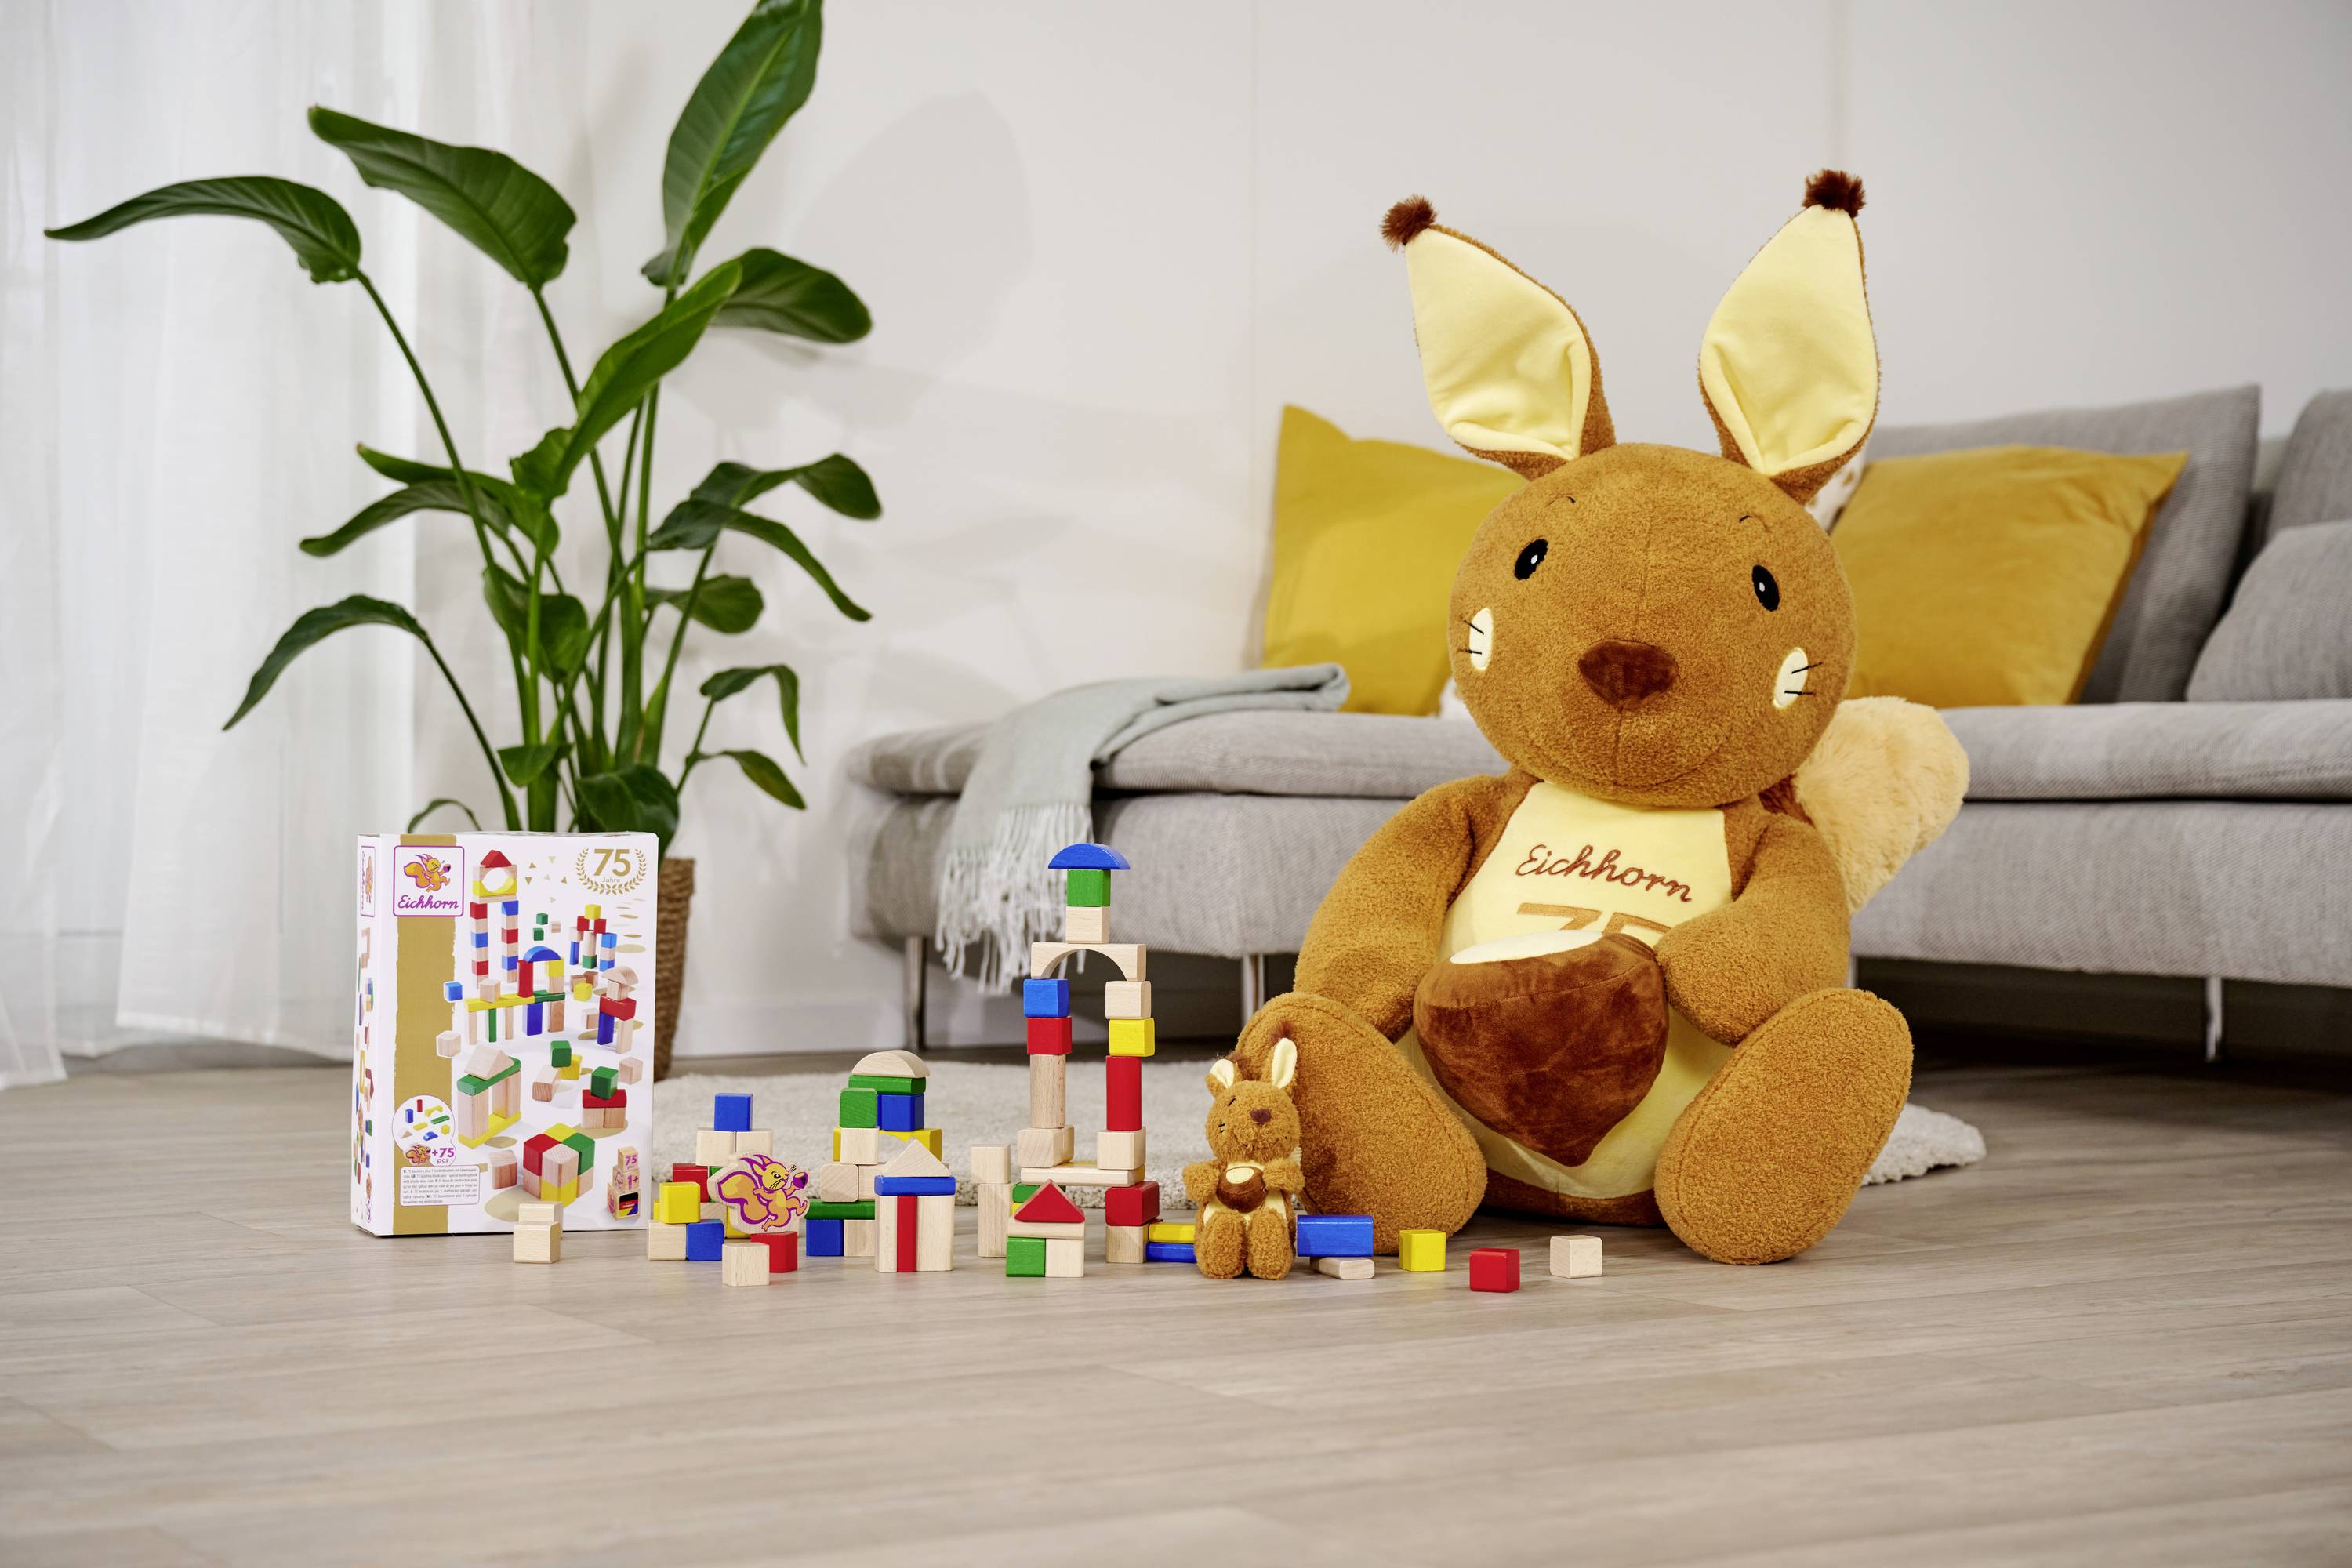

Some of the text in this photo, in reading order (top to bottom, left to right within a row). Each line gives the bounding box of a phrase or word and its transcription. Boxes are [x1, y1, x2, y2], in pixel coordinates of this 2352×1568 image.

[593, 848, 631, 877] 75
[1515, 844, 1692, 902] Eichhorn
[397, 894, 459, 909] Eichhorn
[432, 1147, 455, 1158] +75
[626, 1154, 637, 1166] 75
